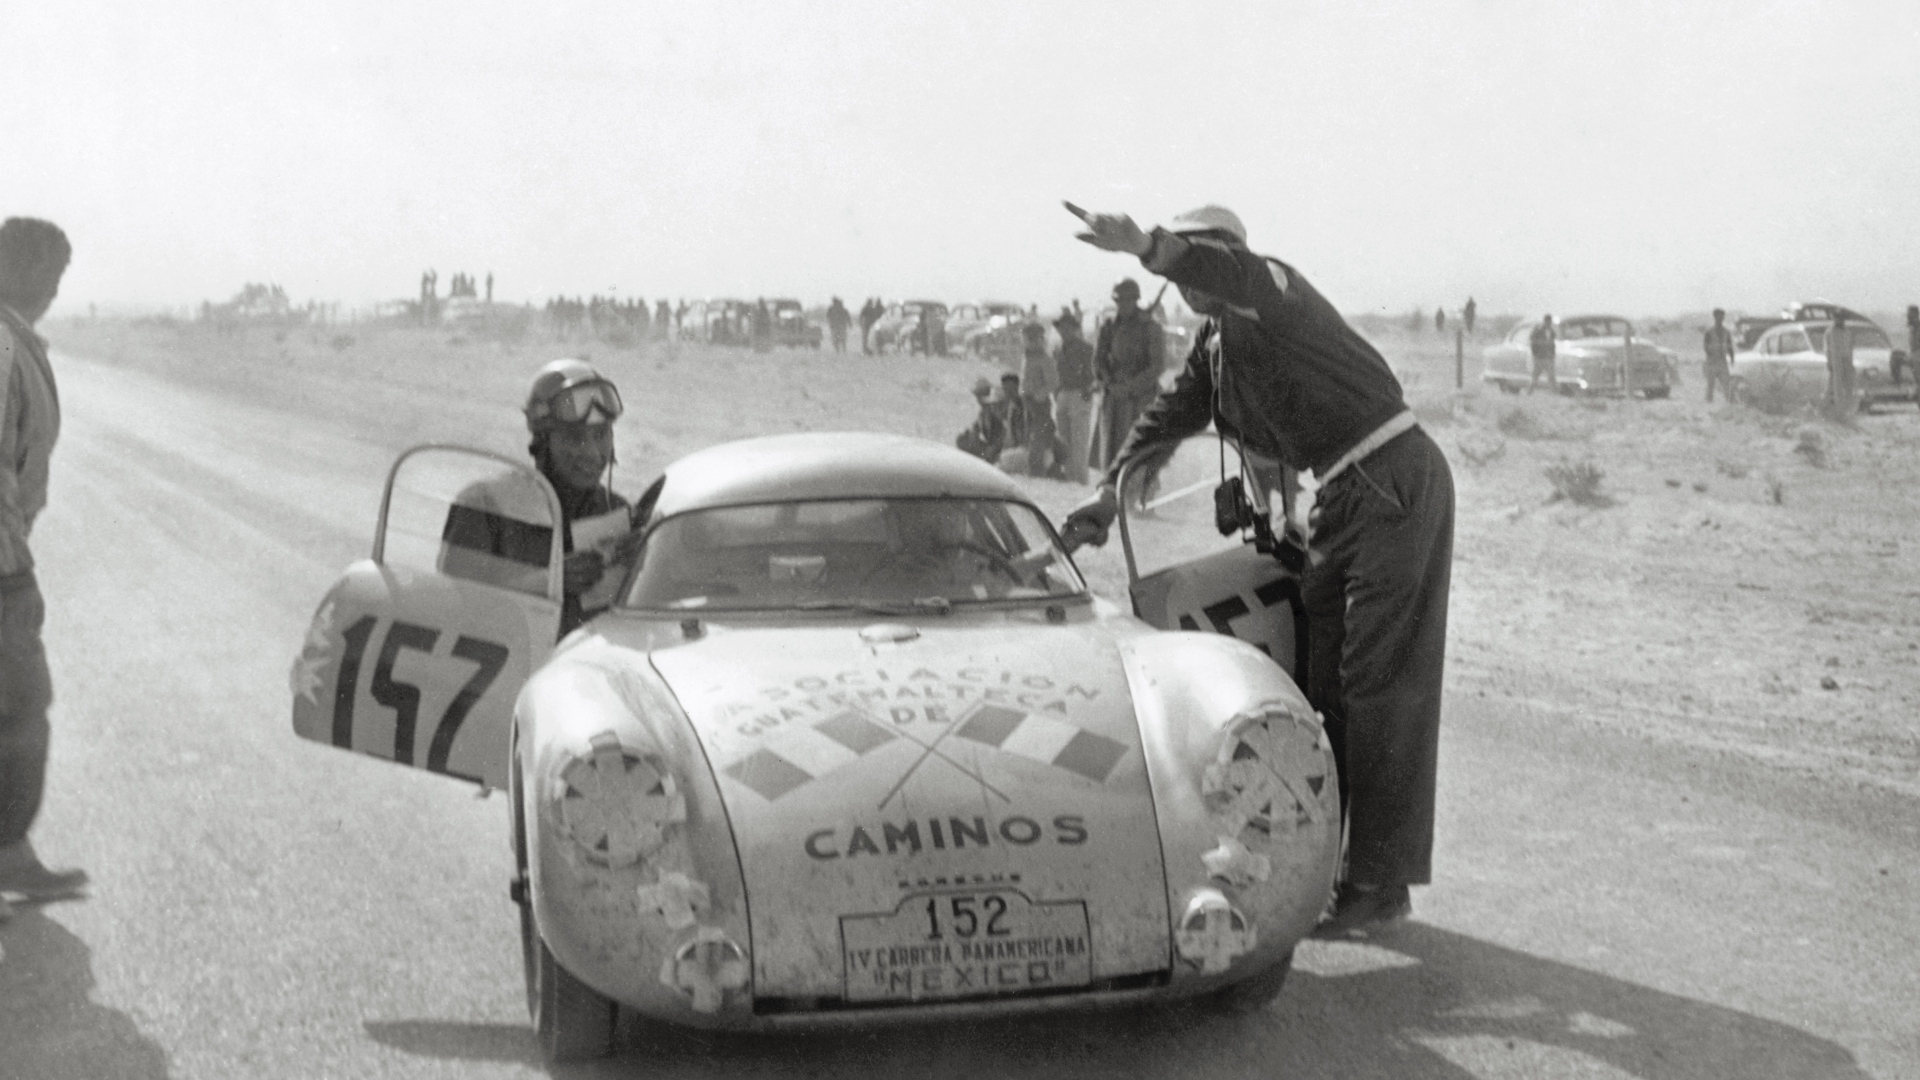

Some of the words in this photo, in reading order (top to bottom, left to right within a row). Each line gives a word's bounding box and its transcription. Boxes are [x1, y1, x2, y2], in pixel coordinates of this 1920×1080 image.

[332, 614, 510, 774] 157
[888, 705, 950, 725] DE
[804, 815, 1089, 861] CAMINOS
[925, 895, 1011, 940] 152
[849, 948, 872, 970] IV
[876, 944, 952, 970] CARRERA
[961, 935, 1086, 961] PANAMERICANA
